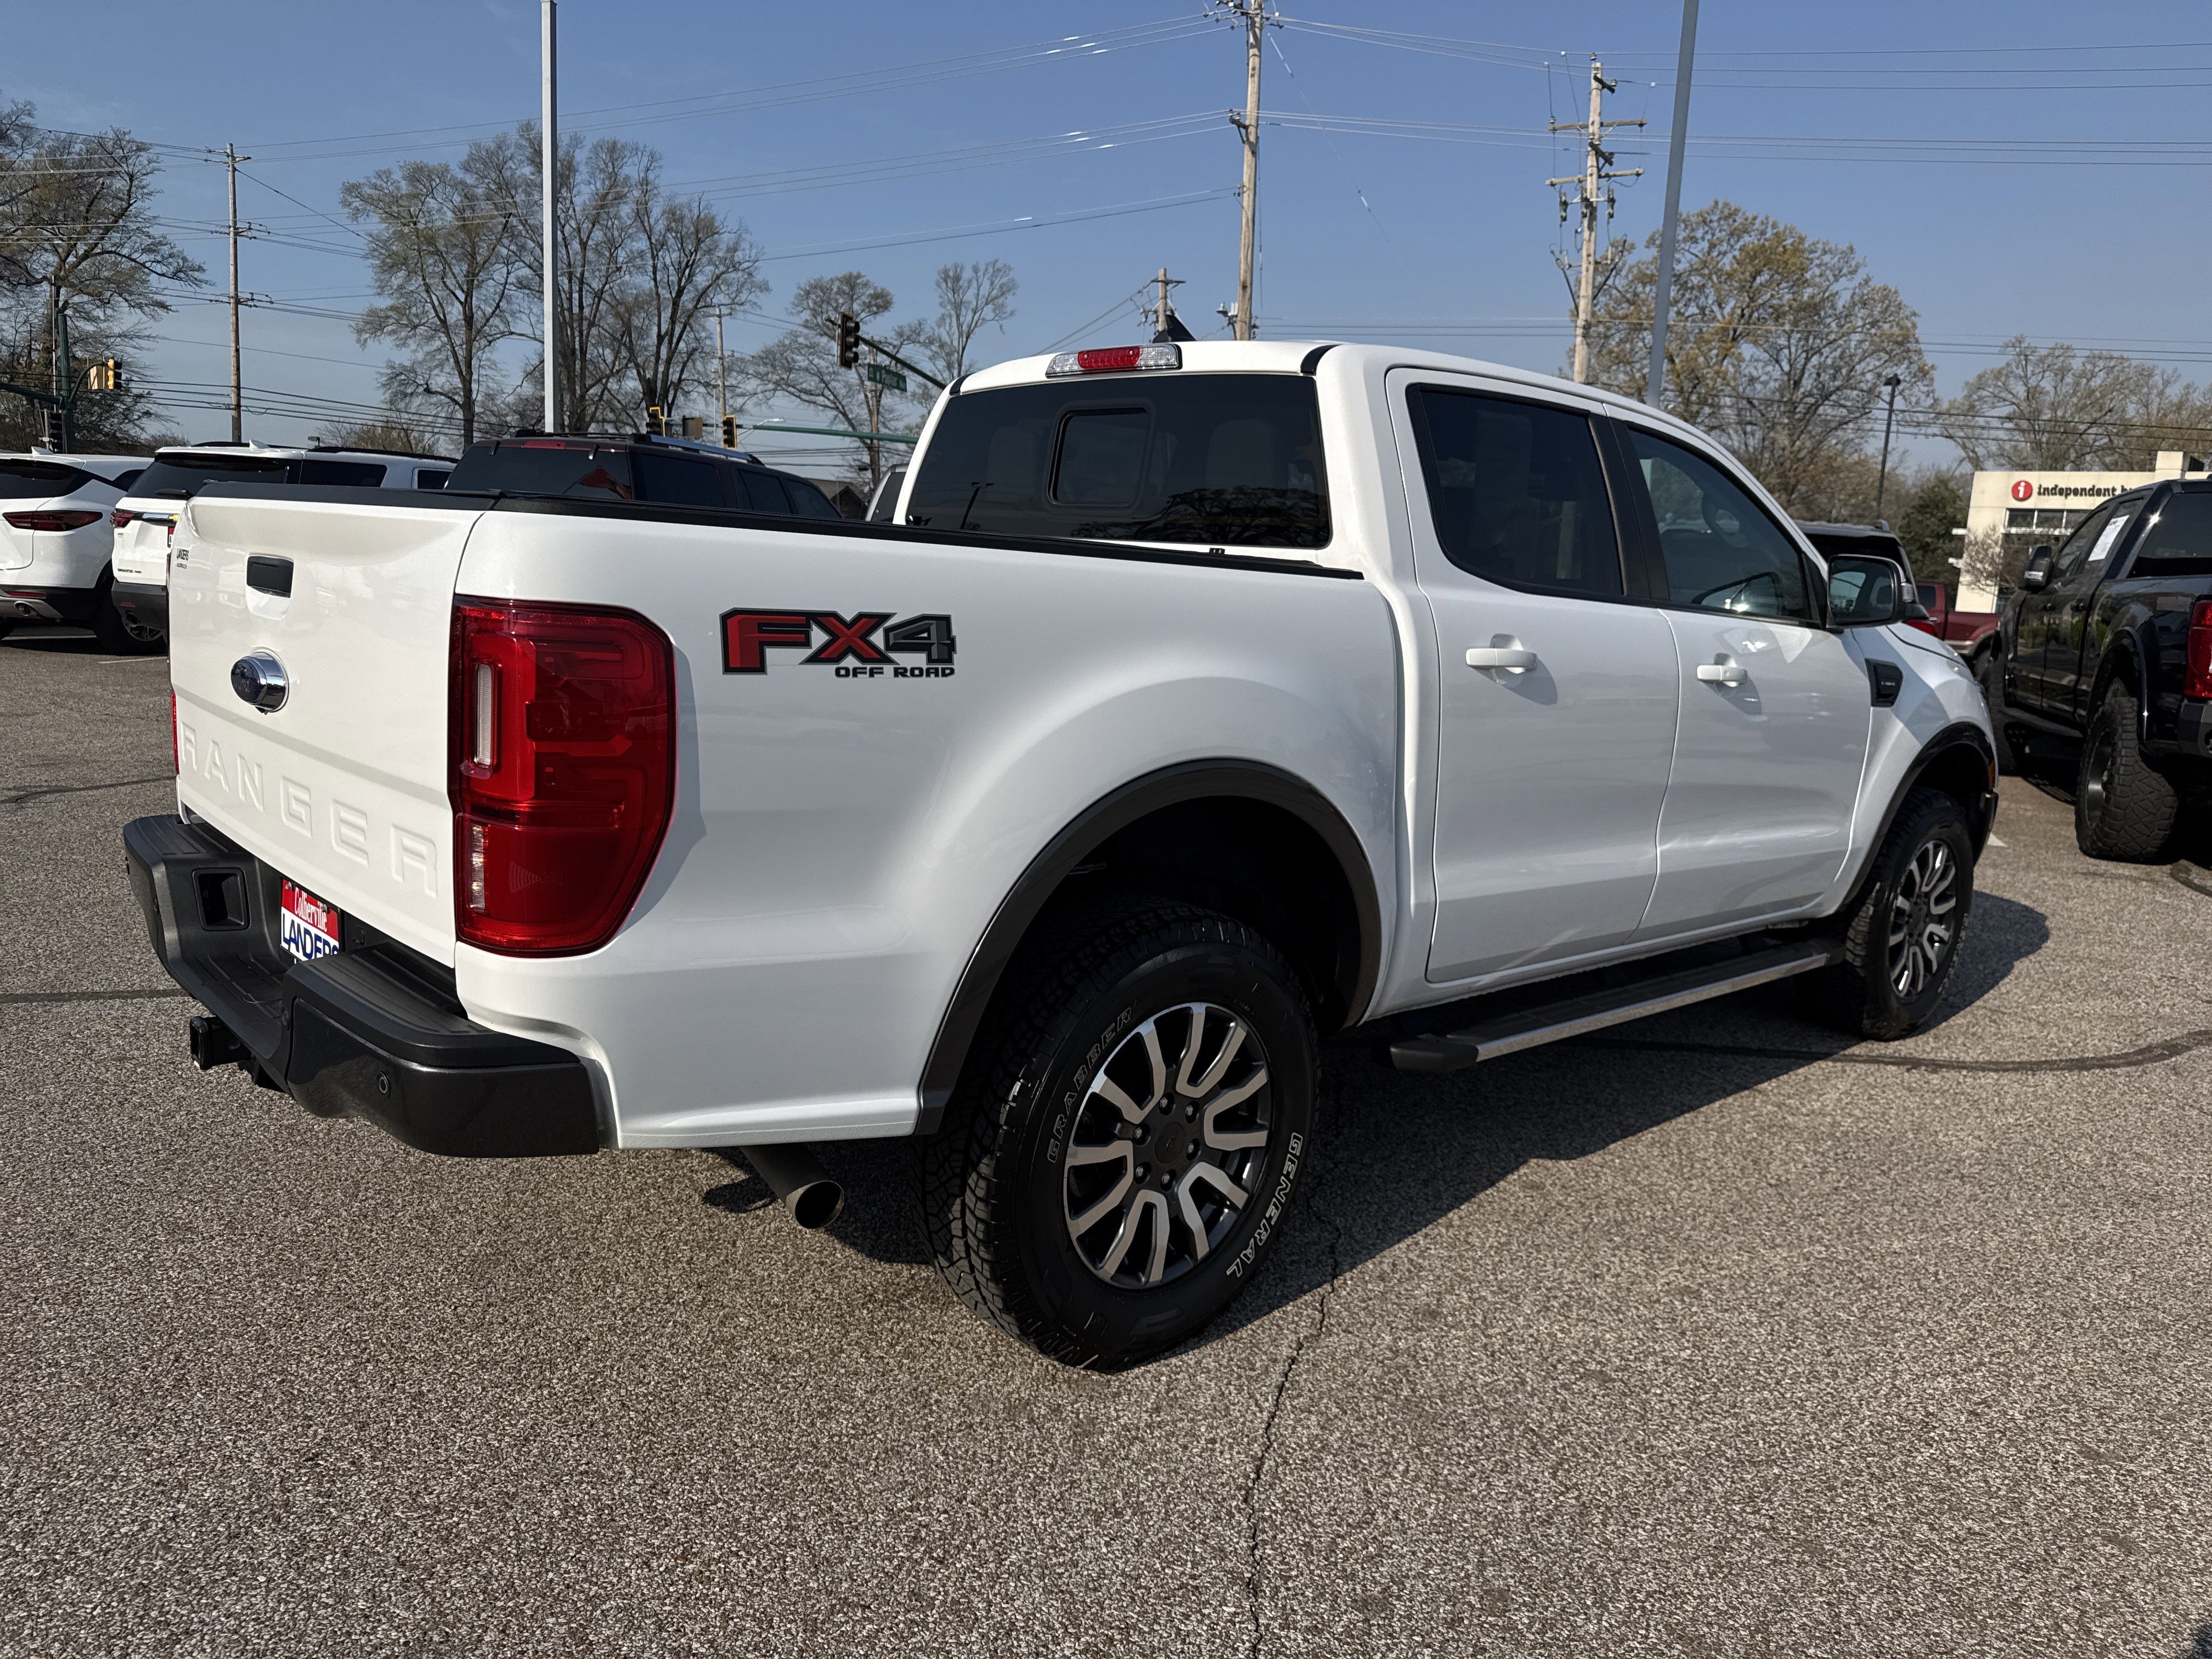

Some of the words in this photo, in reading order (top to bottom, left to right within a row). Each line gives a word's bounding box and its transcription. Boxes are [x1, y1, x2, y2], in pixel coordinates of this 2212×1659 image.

[2037, 483, 2117, 500] independent
[719, 607, 957, 675] FX4
[834, 666, 884, 678] OFF
[893, 666, 955, 679] ROAD
[180, 720, 438, 900] RANGER
[295, 887, 328, 933] Collierville
[1047, 1007, 1132, 1164] GRABBER
[1226, 1132, 1304, 1278] GENERAL
